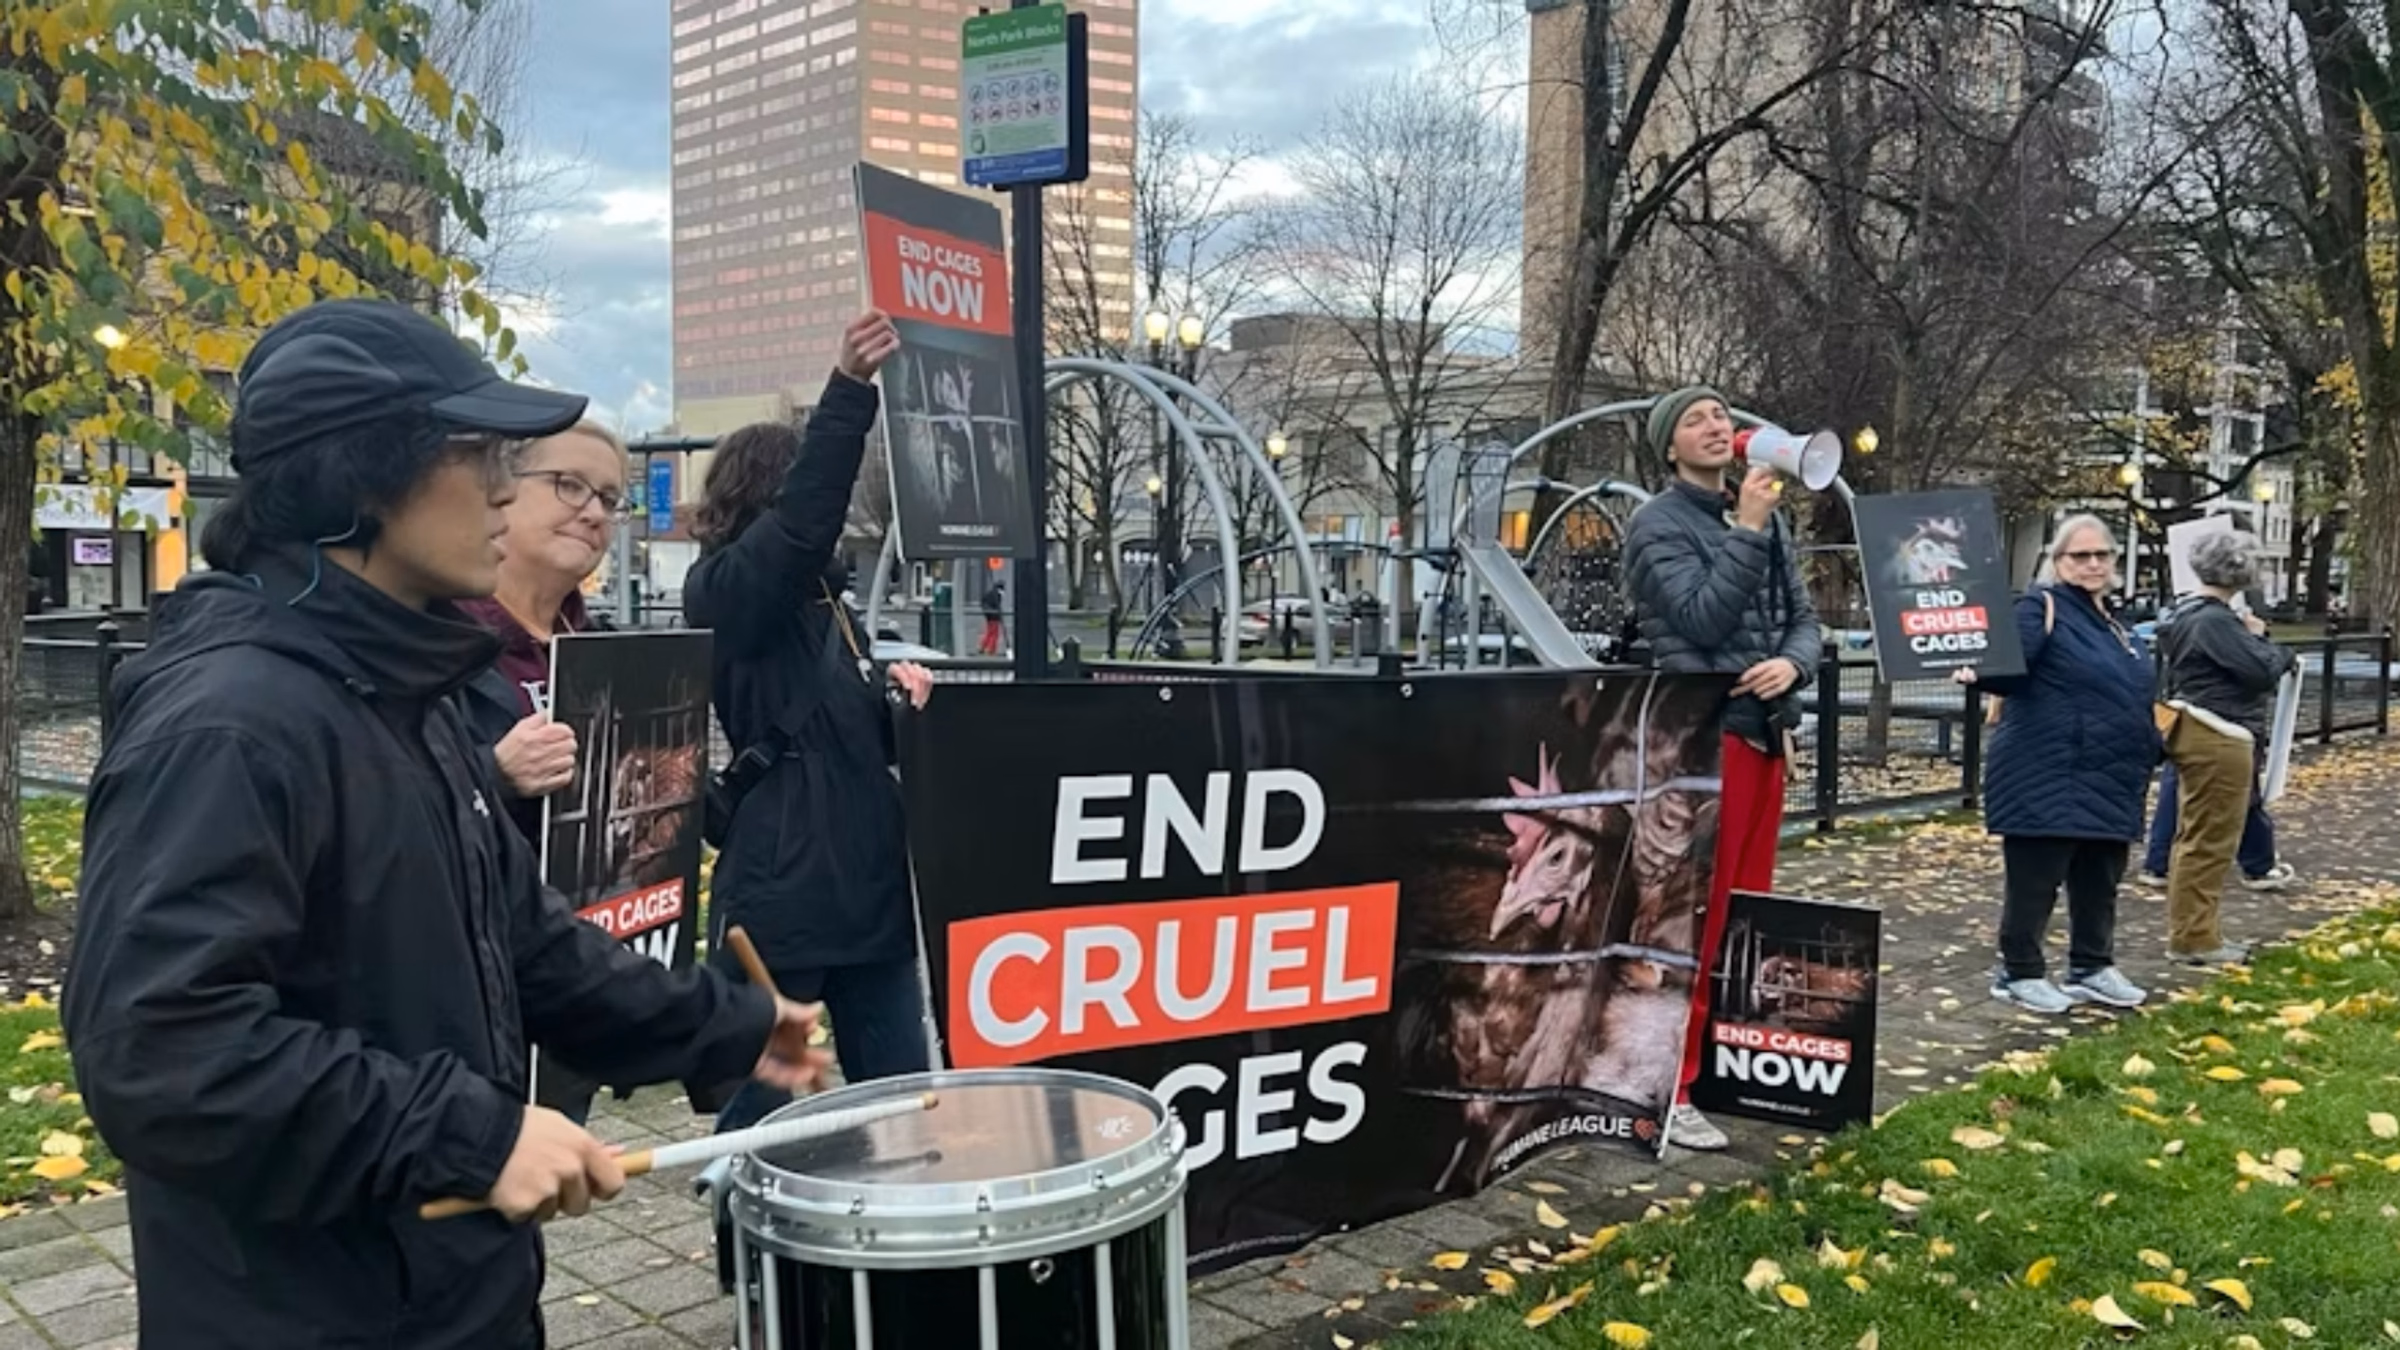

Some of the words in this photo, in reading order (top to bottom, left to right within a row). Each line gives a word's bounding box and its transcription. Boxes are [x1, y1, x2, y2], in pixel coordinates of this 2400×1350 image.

[898, 235, 931, 263] END
[934, 246, 983, 278] CAGES
[902, 261, 984, 324] NOW
[1907, 610, 1984, 631] CRUEL
[1916, 589, 1966, 609] END
[1910, 631, 1988, 654] CAGES
[1050, 768, 1325, 885] END
[618, 885, 681, 931] CAGES
[967, 906, 1378, 1049] CRUEL
[1715, 1023, 1764, 1047] END
[1769, 1032, 1848, 1060] CAGES
[1715, 1043, 1849, 1097] NOW
[1151, 1041, 1368, 1173] GES
